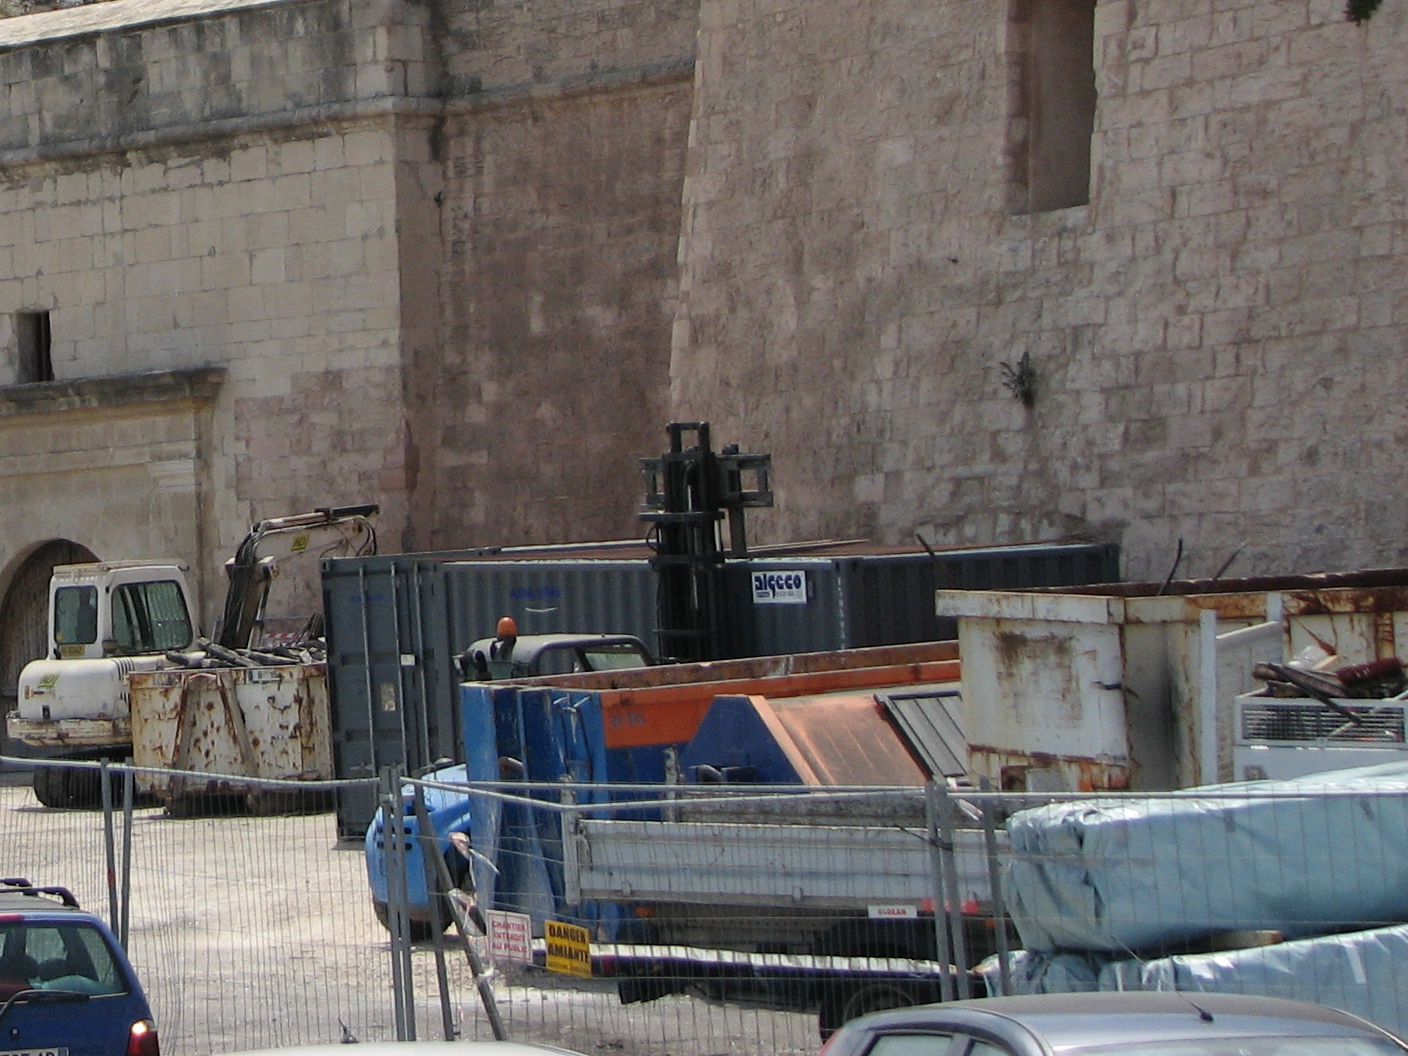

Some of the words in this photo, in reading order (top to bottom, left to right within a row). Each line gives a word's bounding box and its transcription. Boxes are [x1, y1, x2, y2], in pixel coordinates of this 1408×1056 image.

[754, 573, 801, 599] algeco
[548, 923, 587, 944] DANGER
[547, 943, 589, 963] AMIANTE
